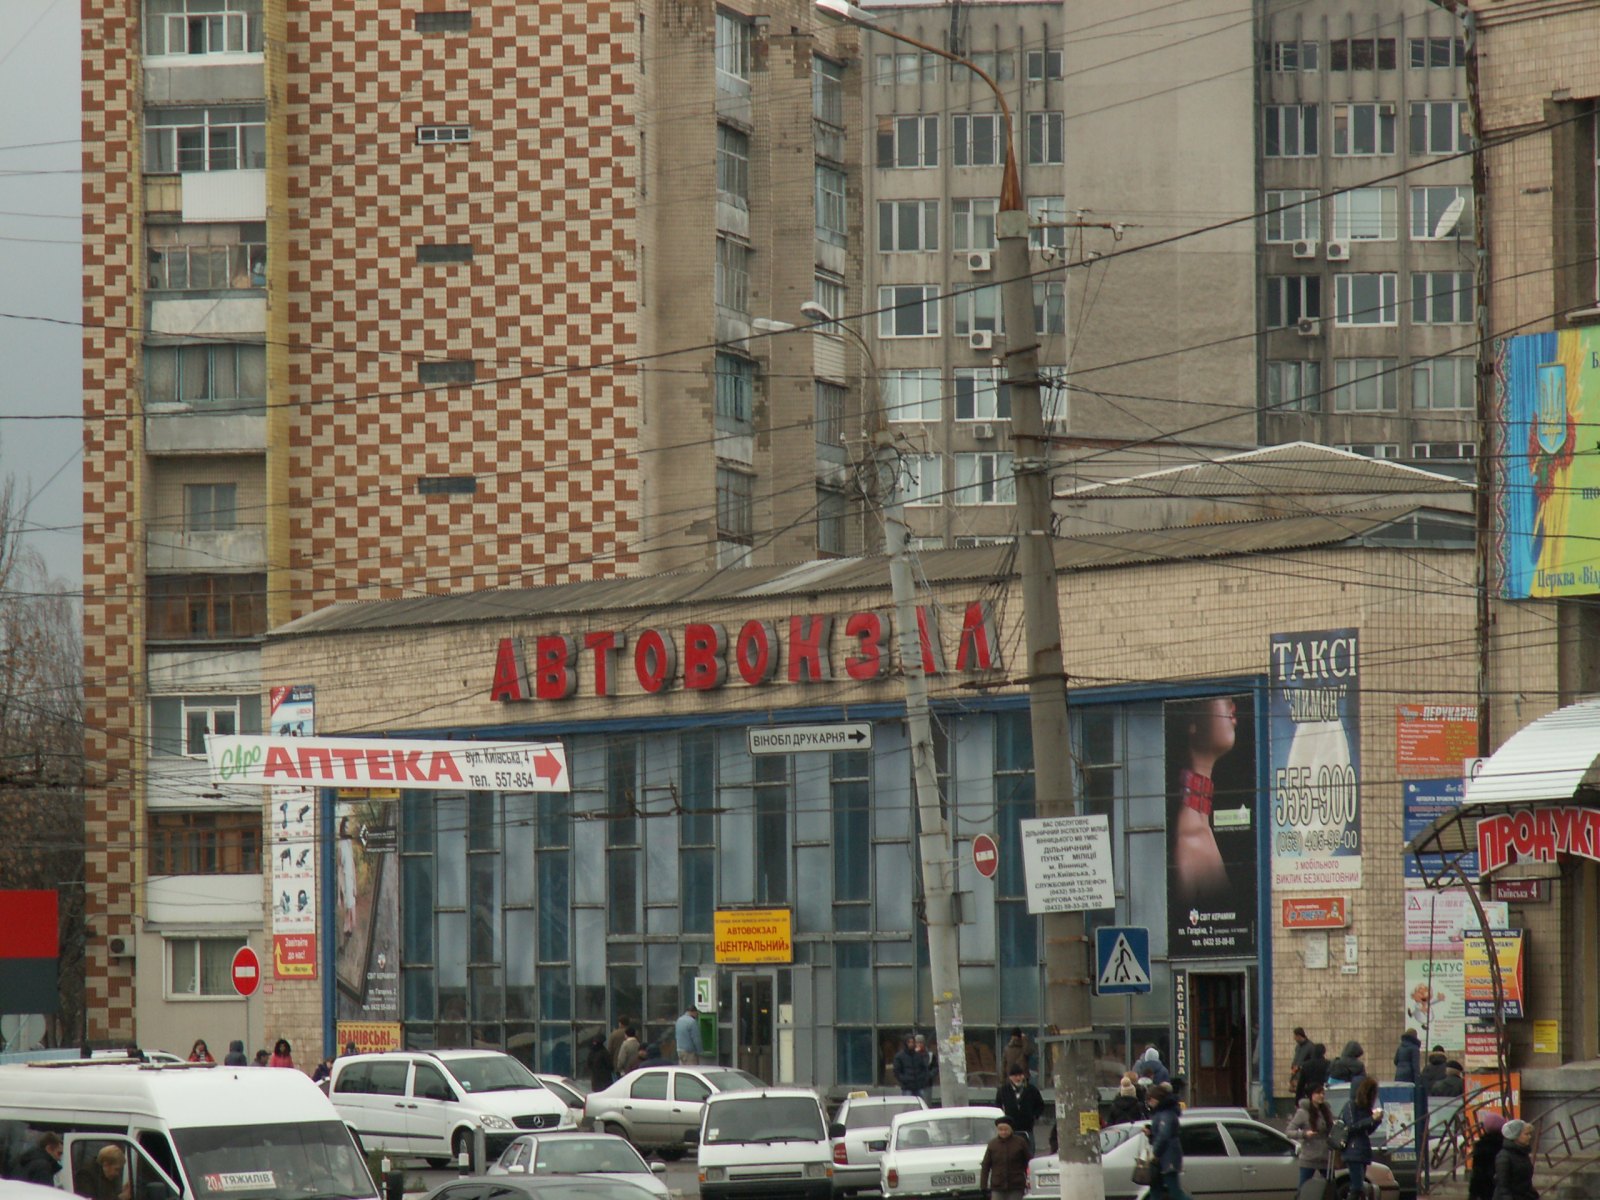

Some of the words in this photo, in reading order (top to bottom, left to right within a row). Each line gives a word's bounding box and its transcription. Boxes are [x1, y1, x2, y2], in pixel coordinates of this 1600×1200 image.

[1537, 569, 1575, 592] Церква
[1273, 638, 1356, 680] ТАКСІ
[263, 746, 464, 783] АПТЕКА
[465, 750, 483, 767] вул.
[524, 749, 530, 764] 4
[469, 775, 491, 787] тел.
[495, 772, 534, 788] 557-854
[1276, 764, 1357, 827] 555-900
[1043, 843, 1092, 855] ДІЛЬНИЧНИЙ
[1040, 854, 1064, 862] ПУНКТ
[1300, 859, 1340, 871] мобільного
[1035, 880, 1075, 889] СЛУЖБОВИЙ
[1076, 878, 1107, 886] ТЕЛЕФОН
[1276, 874, 1302, 885] ВИКЛИК
[1303, 872, 1359, 884] БЕЗКОШТОВНИЙ
[1498, 887, 1528, 899] Київська
[1530, 881, 1537, 898] 4
[1073, 894, 1103, 902] ЧАСТИНА
[727, 926, 777, 935] АВТОВОКЗАЛ
[716, 937, 790, 954] «ЦЕНТРАЛЬНИЙ»
[1422, 962, 1463, 972] СТАТУС
[337, 1029, 391, 1047] ІВАНІВСЬКІ
[223, 1173, 271, 1185] ТЯЖИЛІВ
